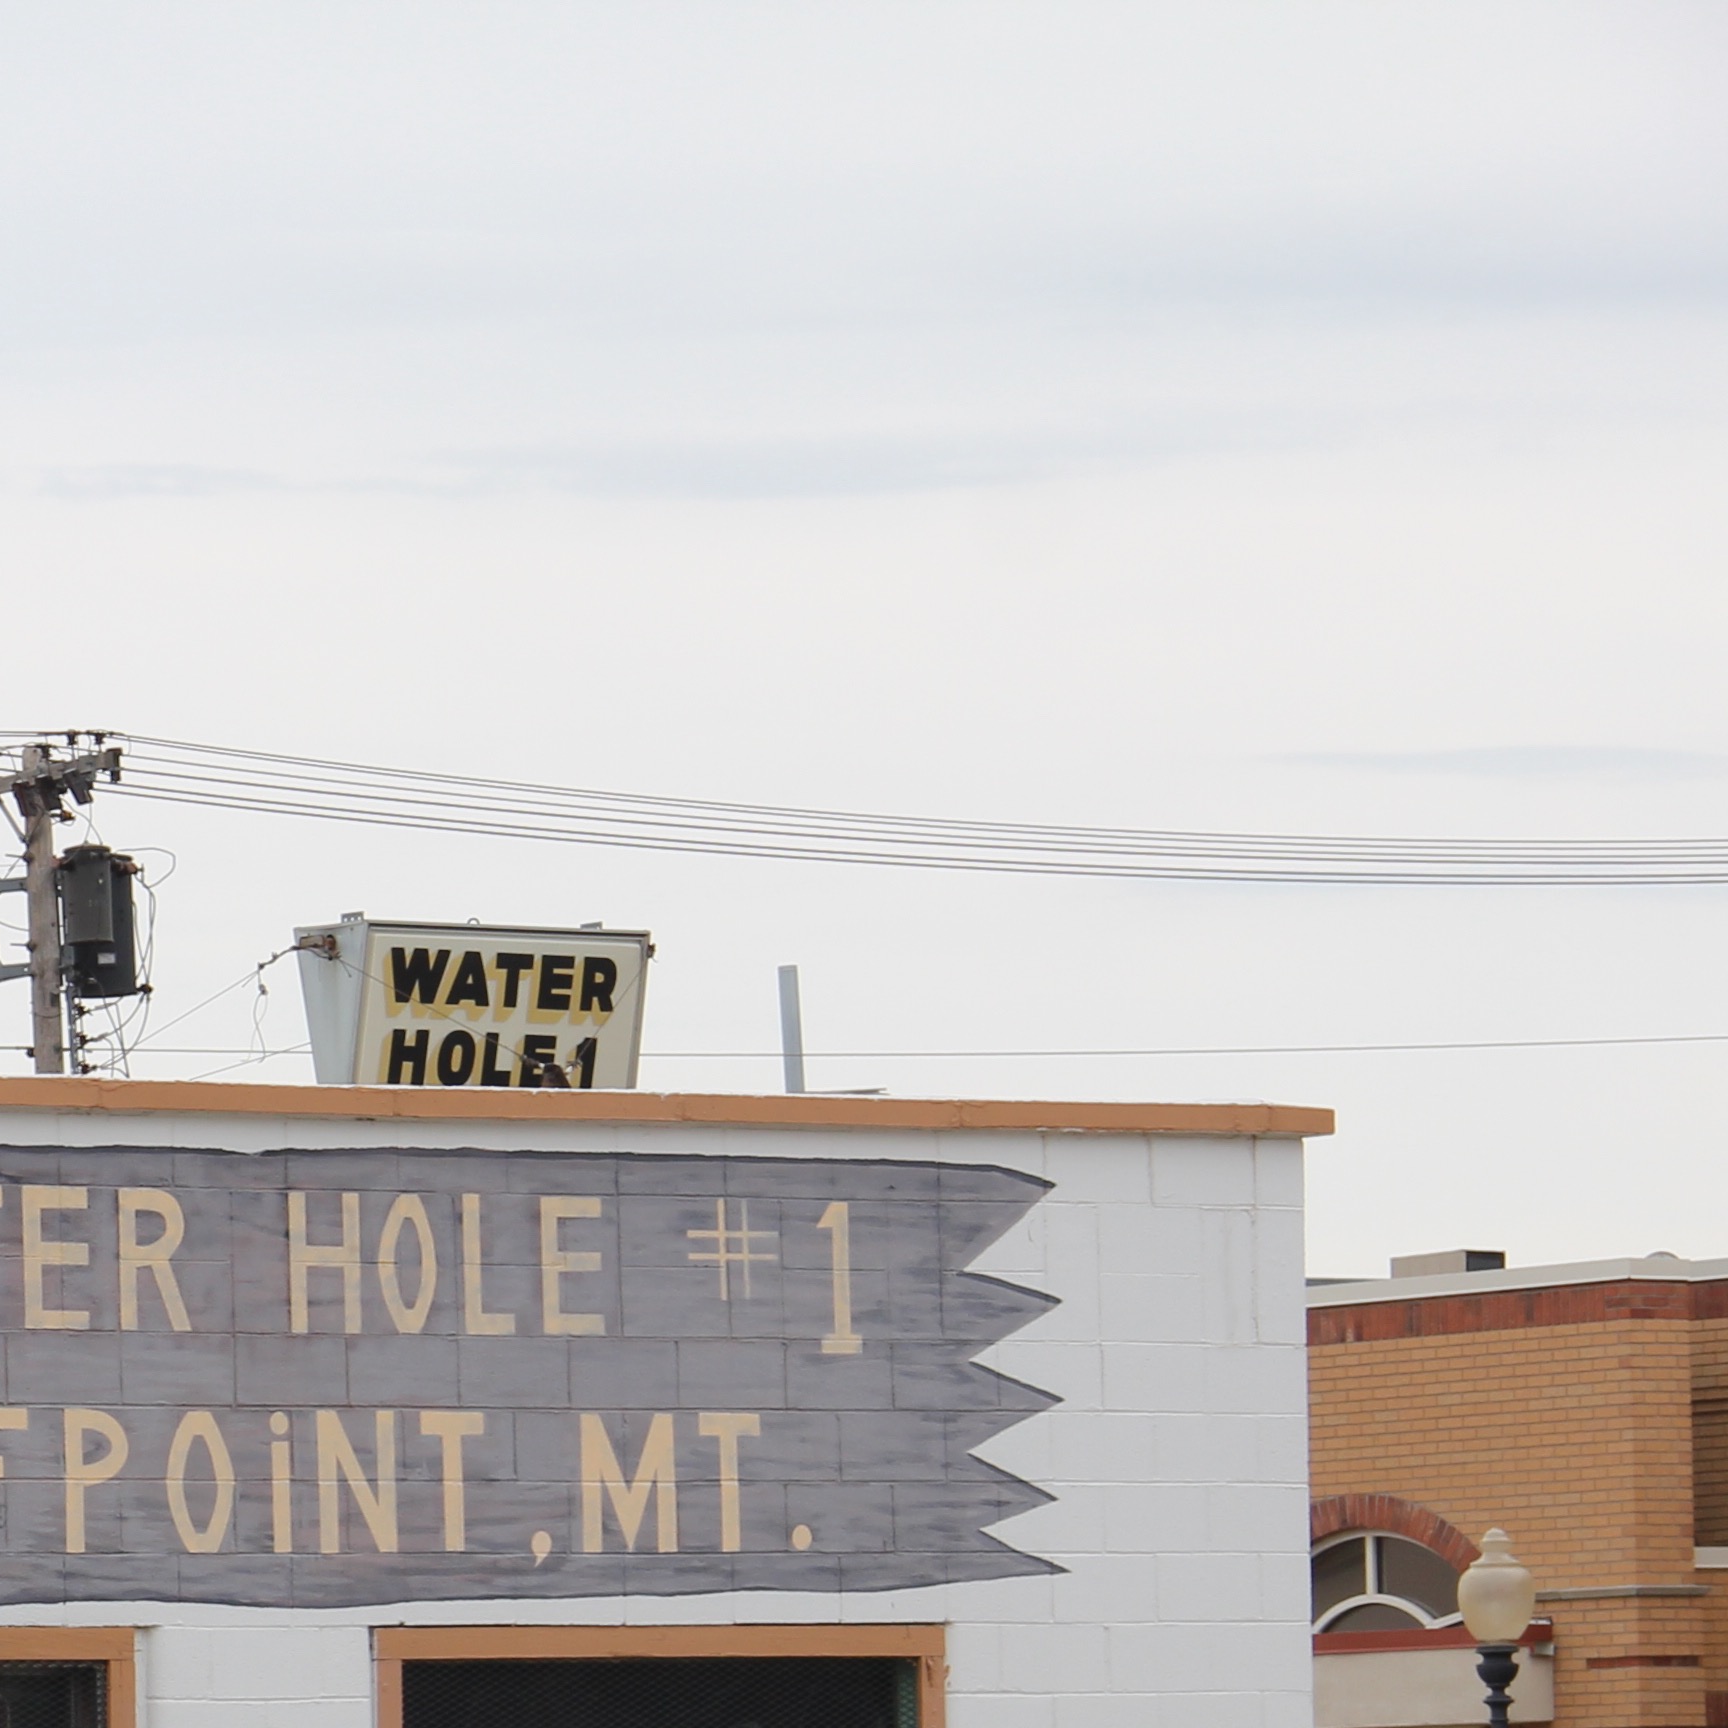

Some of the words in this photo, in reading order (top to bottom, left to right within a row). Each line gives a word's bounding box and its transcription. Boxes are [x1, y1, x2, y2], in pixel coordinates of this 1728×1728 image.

[390, 946, 618, 1013] WATER
[387, 1028, 558, 1087] HOLE
[287, 1191, 606, 1335] HOLE
